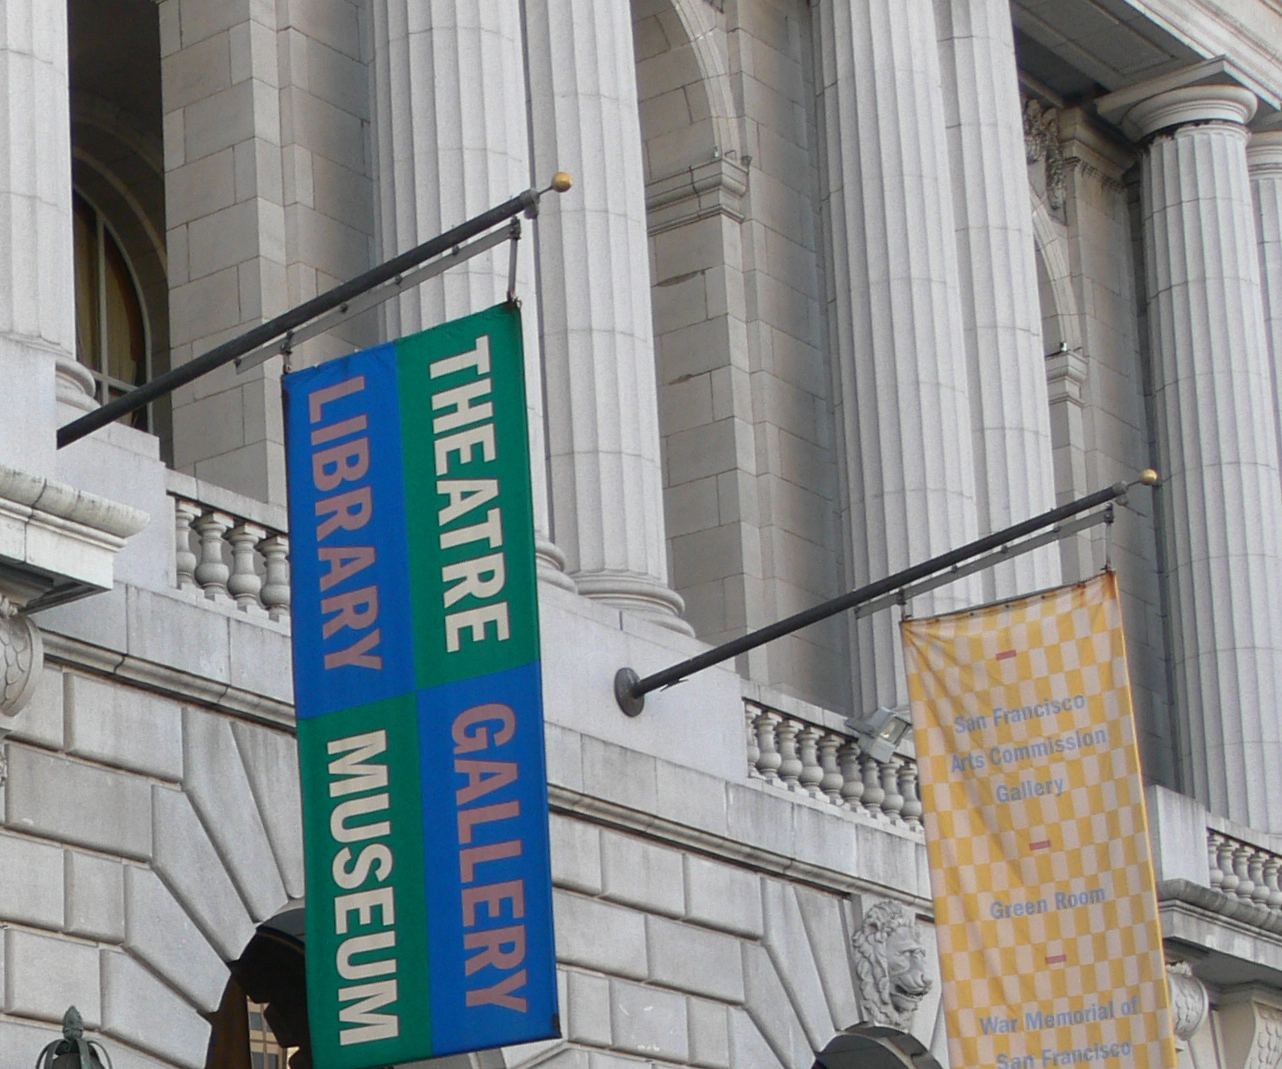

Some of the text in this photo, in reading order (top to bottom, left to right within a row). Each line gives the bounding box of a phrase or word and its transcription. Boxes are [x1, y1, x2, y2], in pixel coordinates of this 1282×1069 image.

[429, 333, 511, 653] THEATRE
[308, 375, 382, 671] LIBRARY
[955, 694, 1085, 734] San Francisco
[951, 728, 1107, 773] Arts Commission
[996, 778, 1064, 803] Gallery
[451, 702, 528, 1013] GALLERY
[327, 728, 399, 1046] MUSEUM
[990, 887, 1105, 920] Green Room
[980, 995, 1139, 1035] War Memorial of
[1042, 1041, 1132, 1068] Francisco
